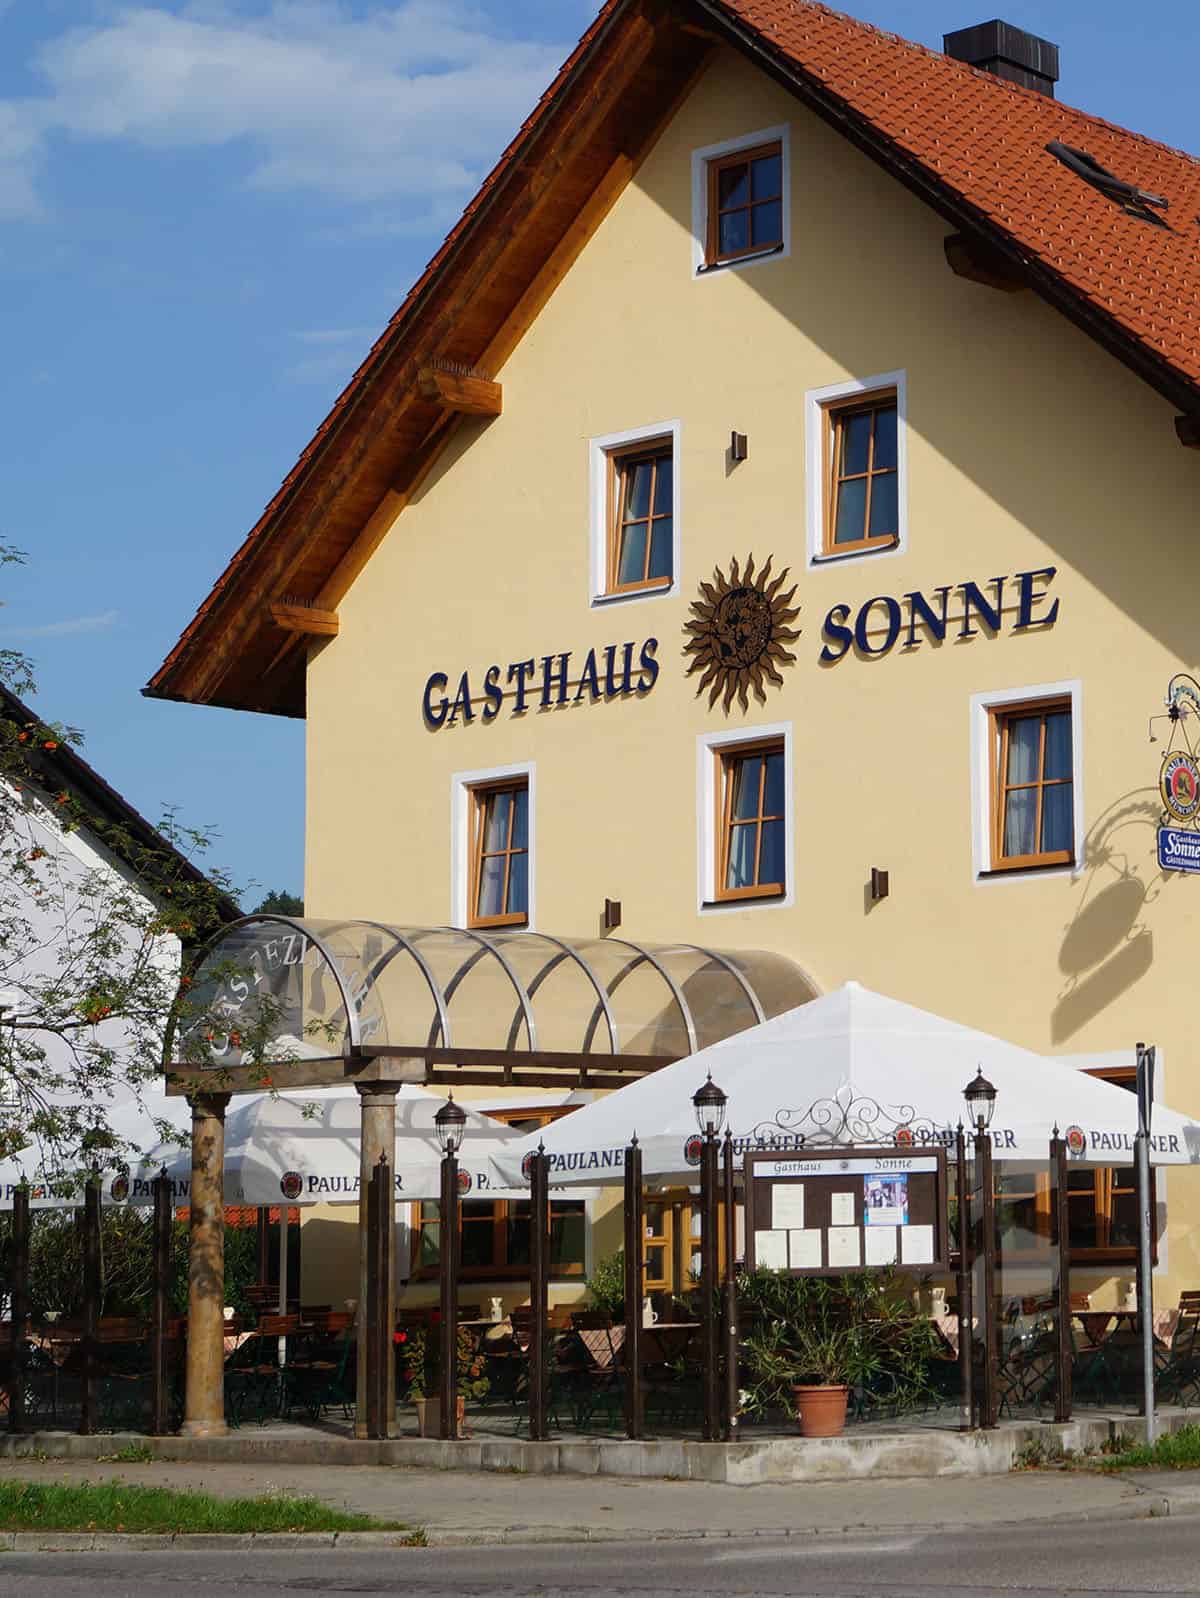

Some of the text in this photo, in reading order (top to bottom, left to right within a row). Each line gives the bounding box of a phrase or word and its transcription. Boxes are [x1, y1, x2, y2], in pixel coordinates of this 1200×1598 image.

[423, 566, 1059, 727] GASTHAUS SONNE
[1164, 832, 1200, 859] Sonne
[1090, 1130, 1180, 1152] PAULNER
[548, 1147, 628, 1172] PAULANE
[773, 1157, 913, 1173] Gasthaus Sonne
[308, 1174, 404, 1193] PAULAR
